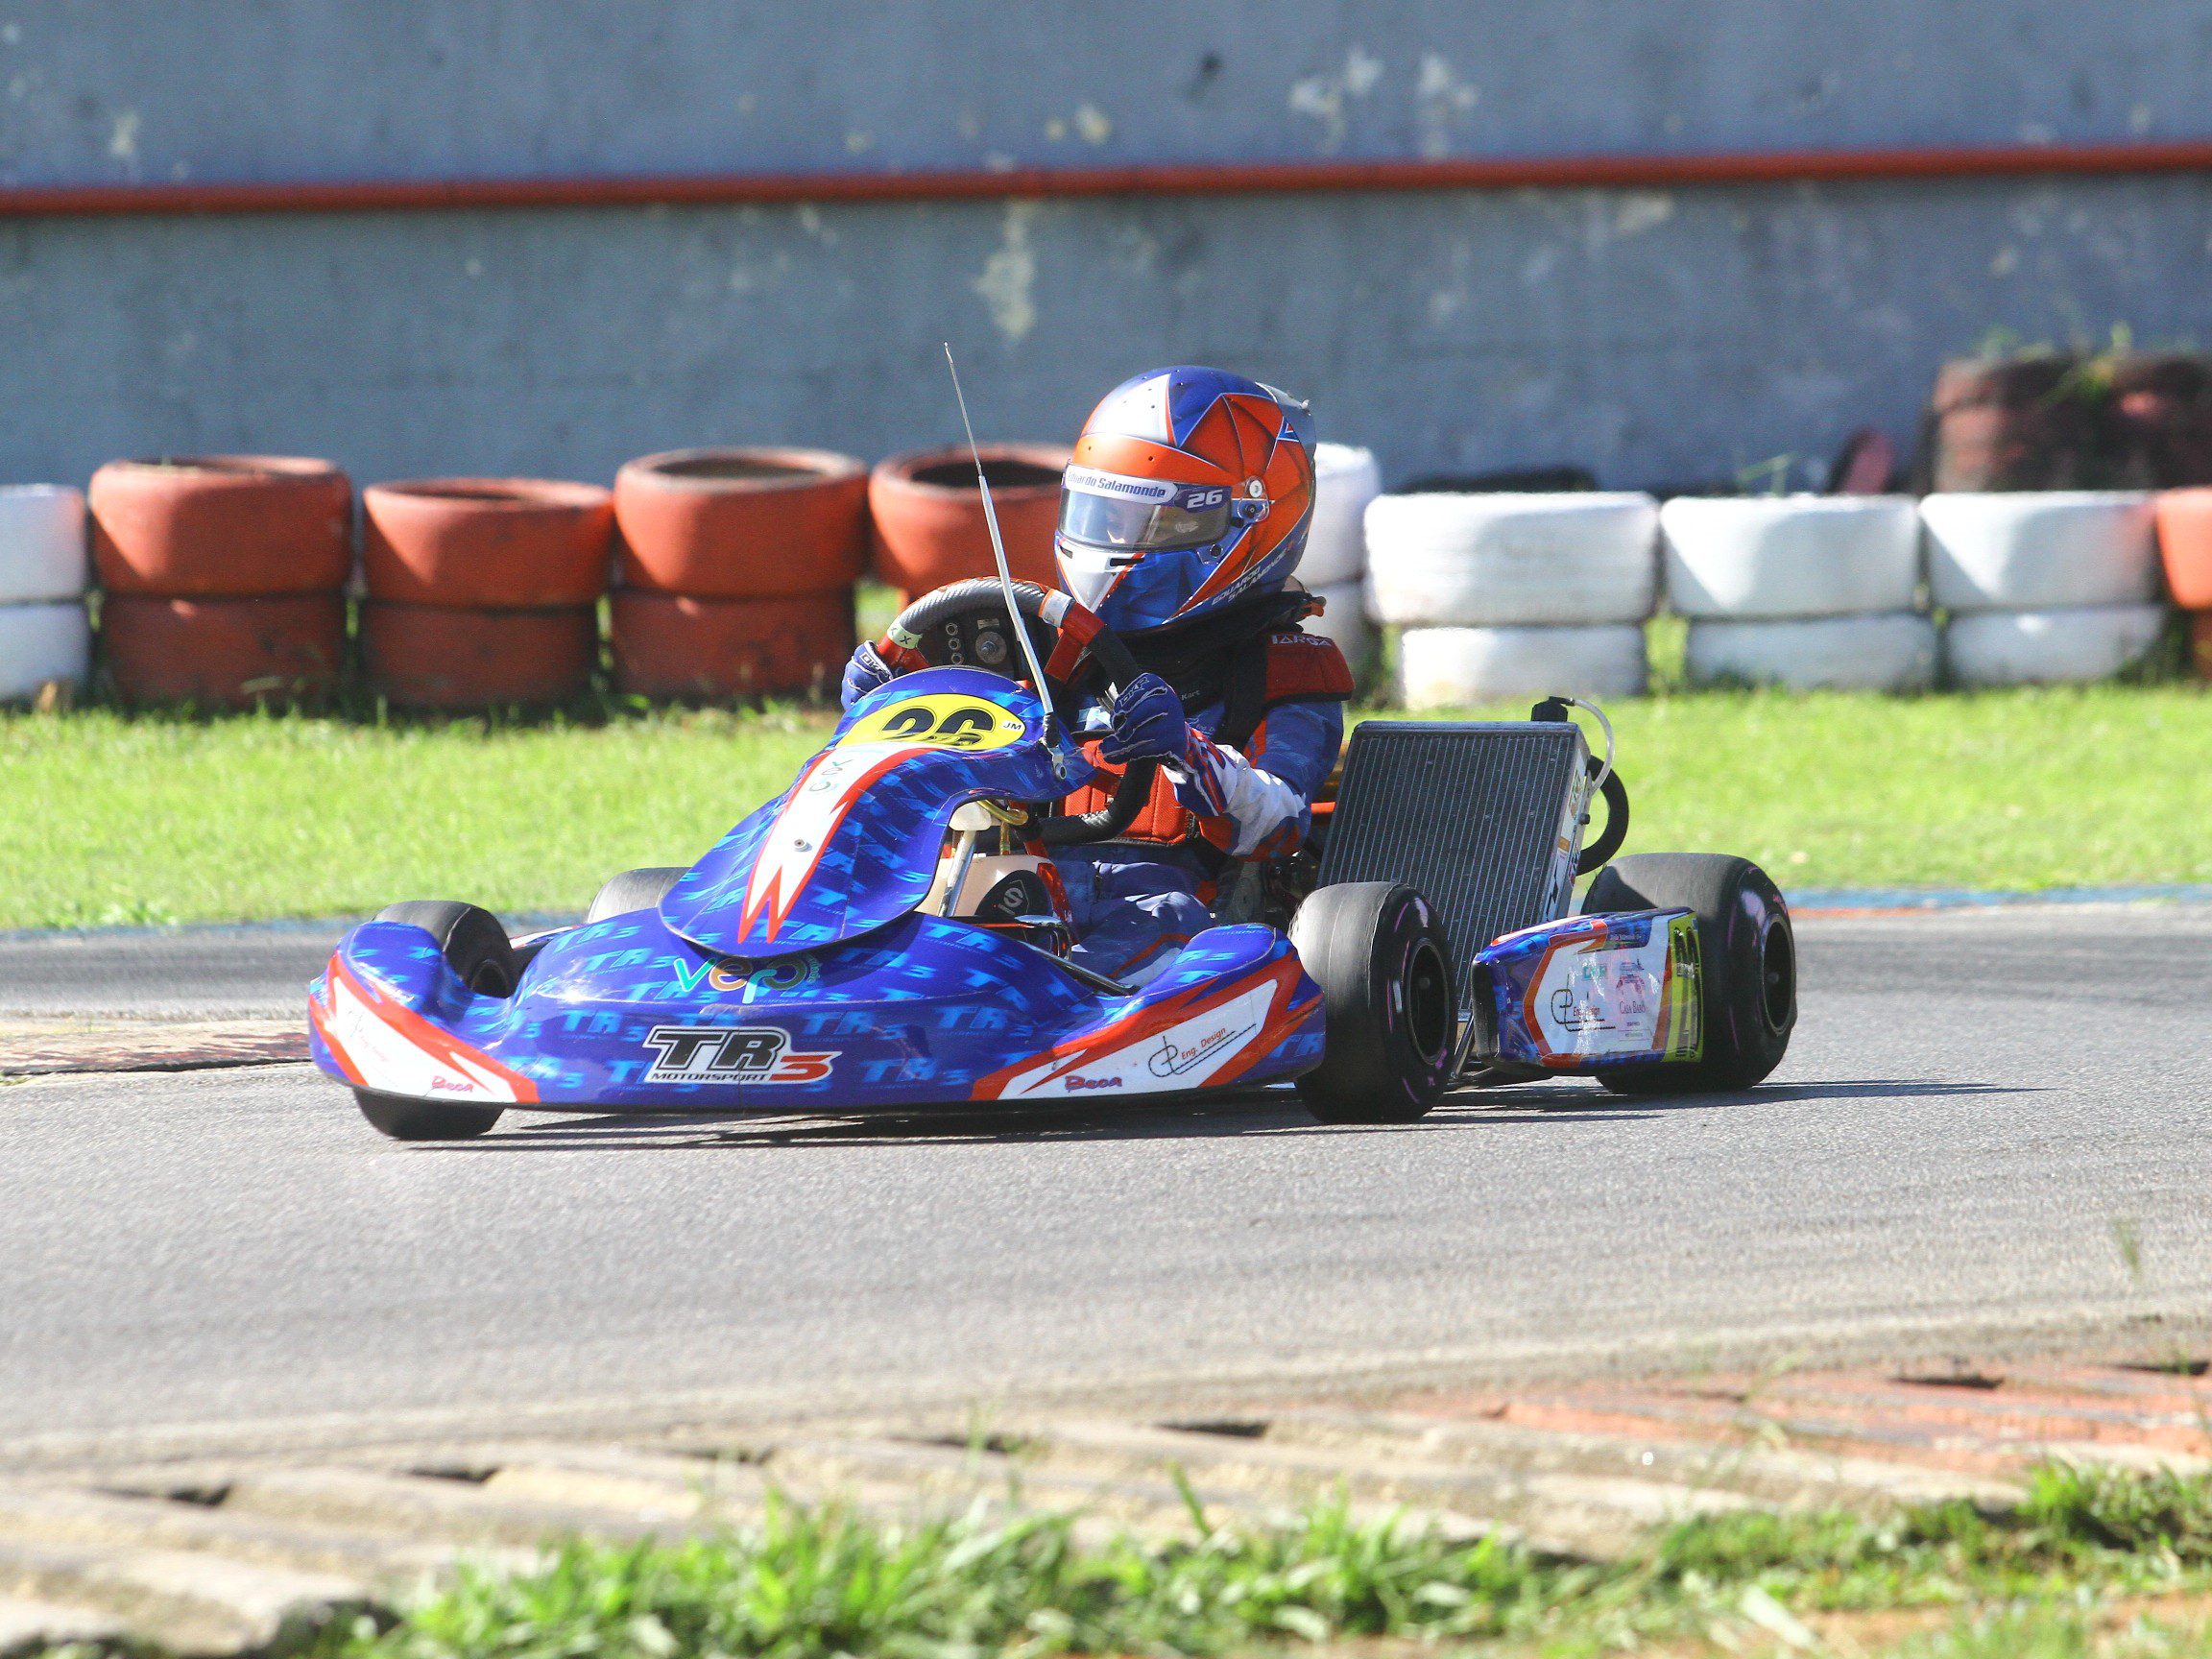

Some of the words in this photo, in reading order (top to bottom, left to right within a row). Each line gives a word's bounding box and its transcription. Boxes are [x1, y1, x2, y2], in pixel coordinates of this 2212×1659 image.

[1097, 477, 1166, 498] Salamonde
[1187, 489, 1223, 509] 26
[878, 705, 997, 747] 26
[1181, 1046, 1199, 1060] Eng.
[1200, 1027, 1227, 1048] Design
[651, 1071, 770, 1082] MOTORSPORT
